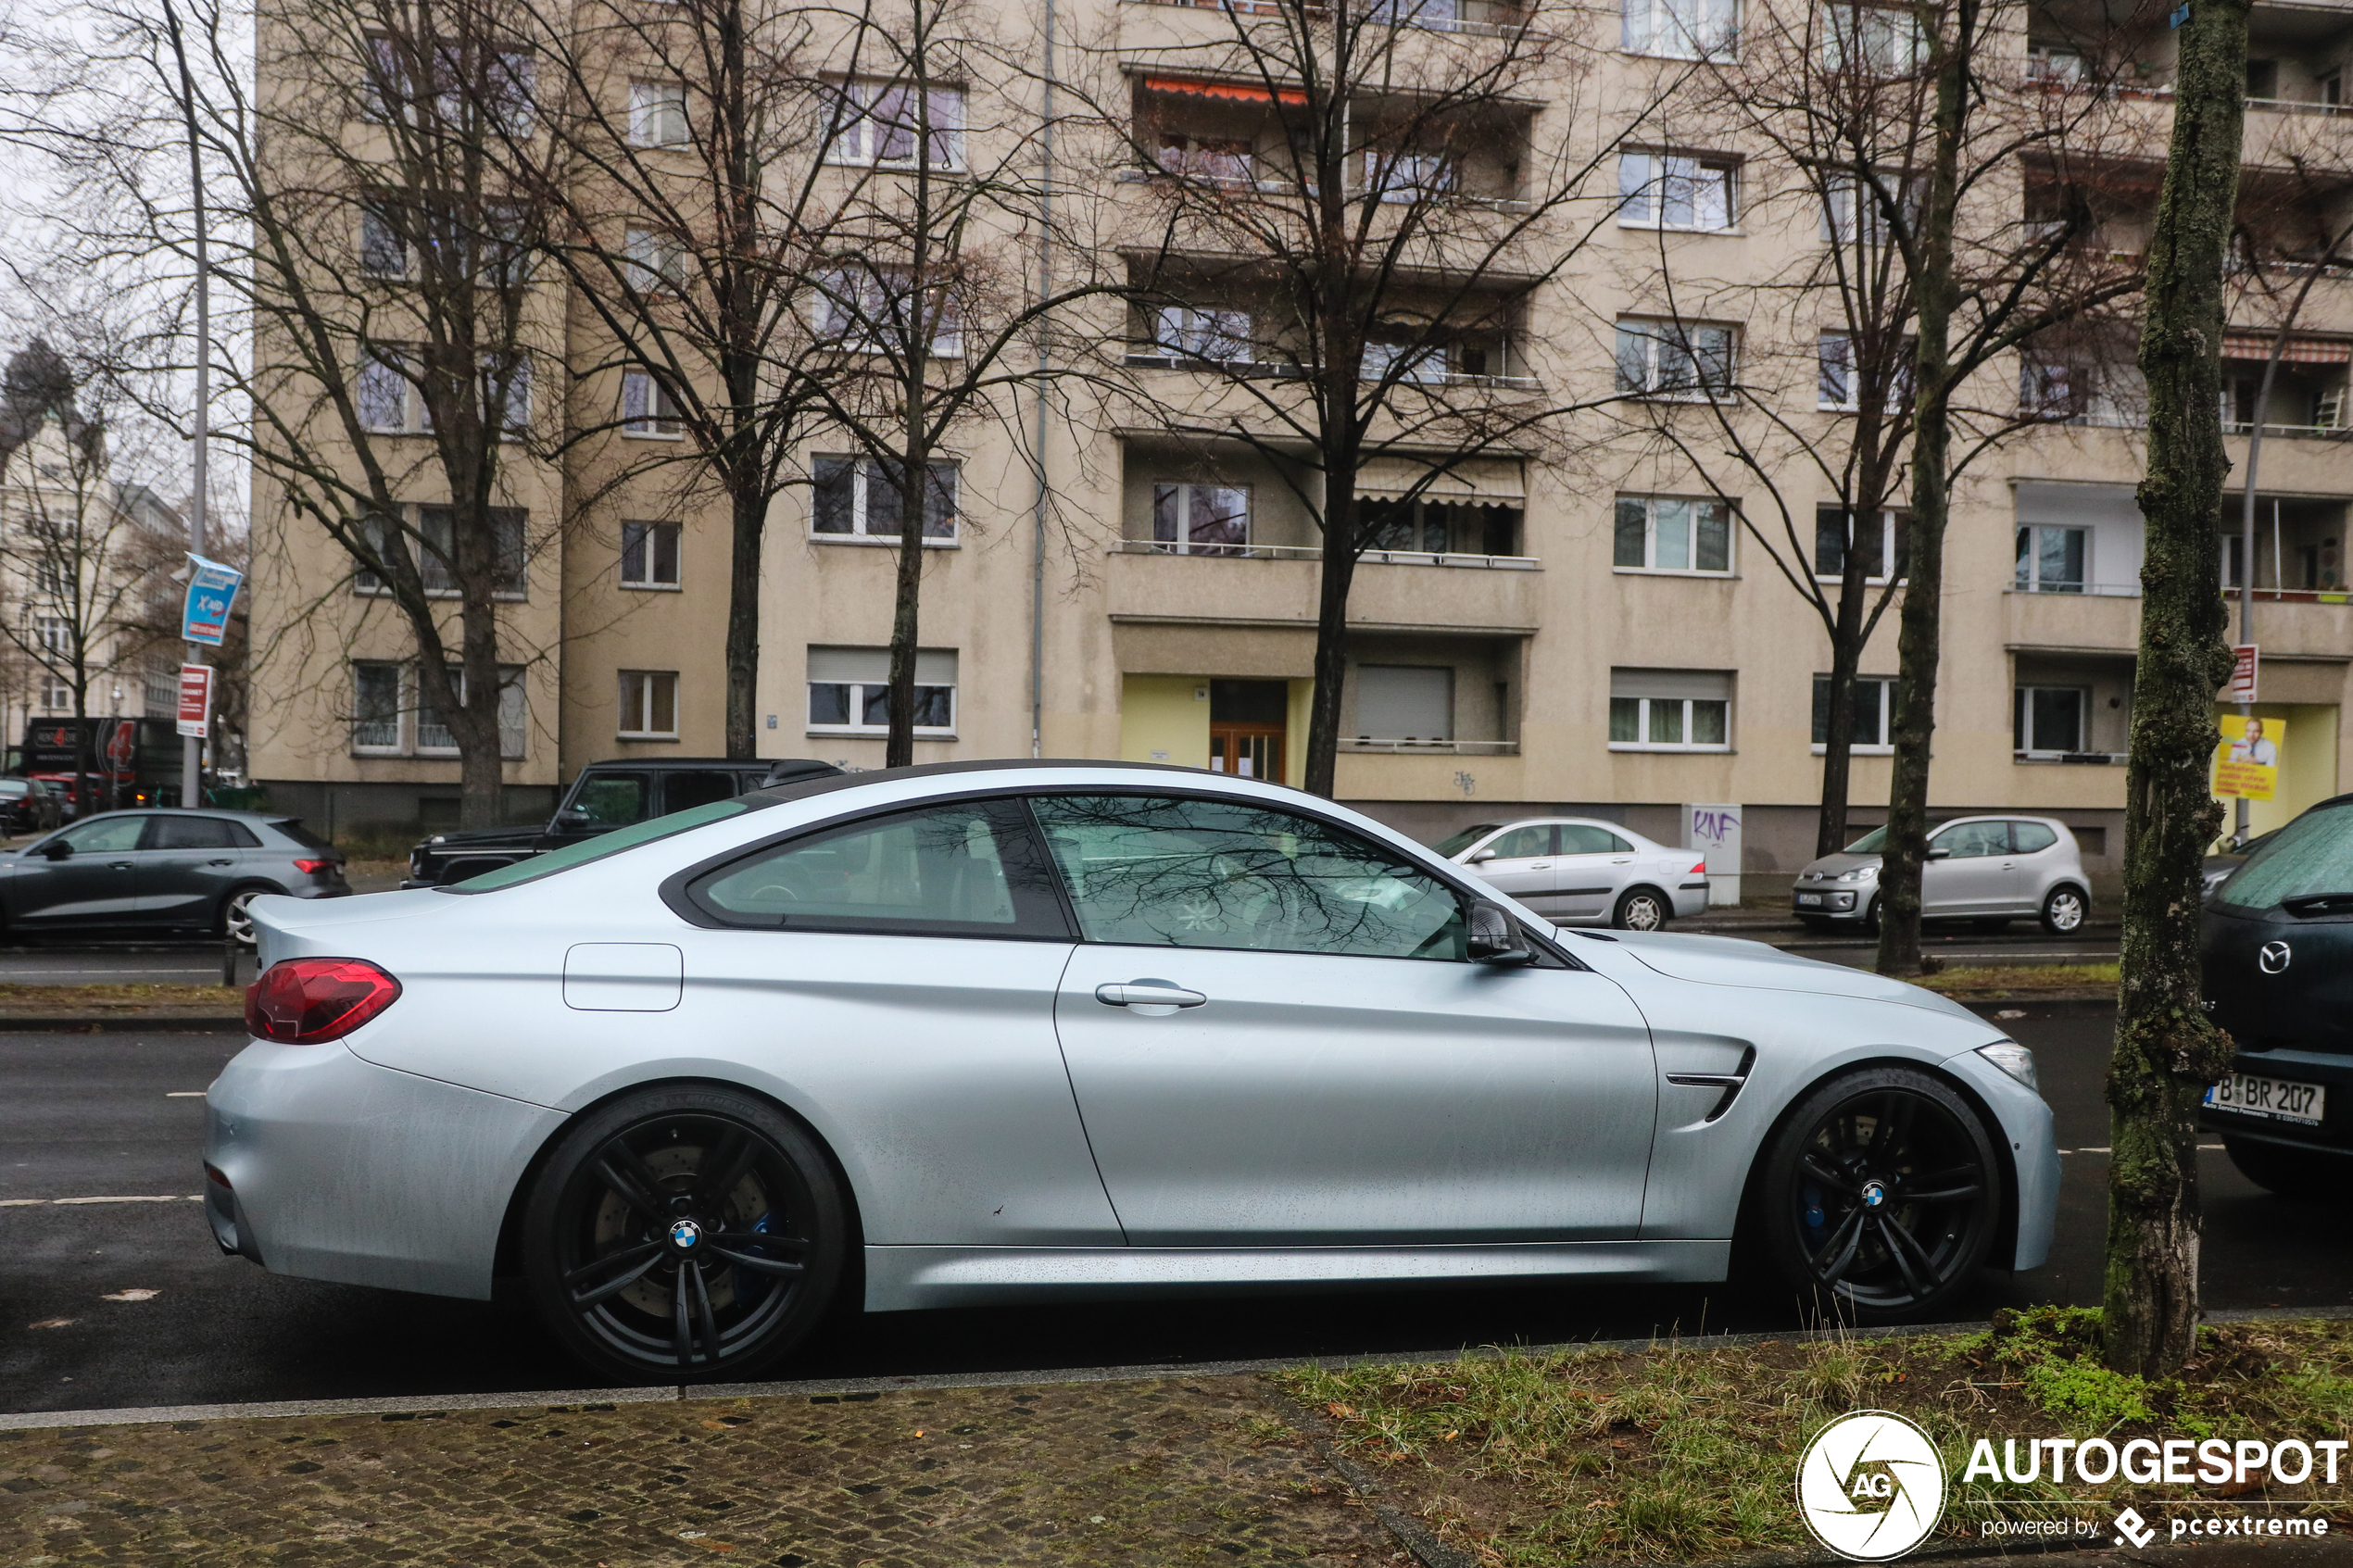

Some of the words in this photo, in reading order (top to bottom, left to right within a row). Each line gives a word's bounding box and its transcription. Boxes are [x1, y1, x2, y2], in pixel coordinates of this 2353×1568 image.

[2221, 1076, 2233, 1101] B
[2246, 1078, 2271, 1109] BR
[2277, 1083, 2317, 1115] 207
